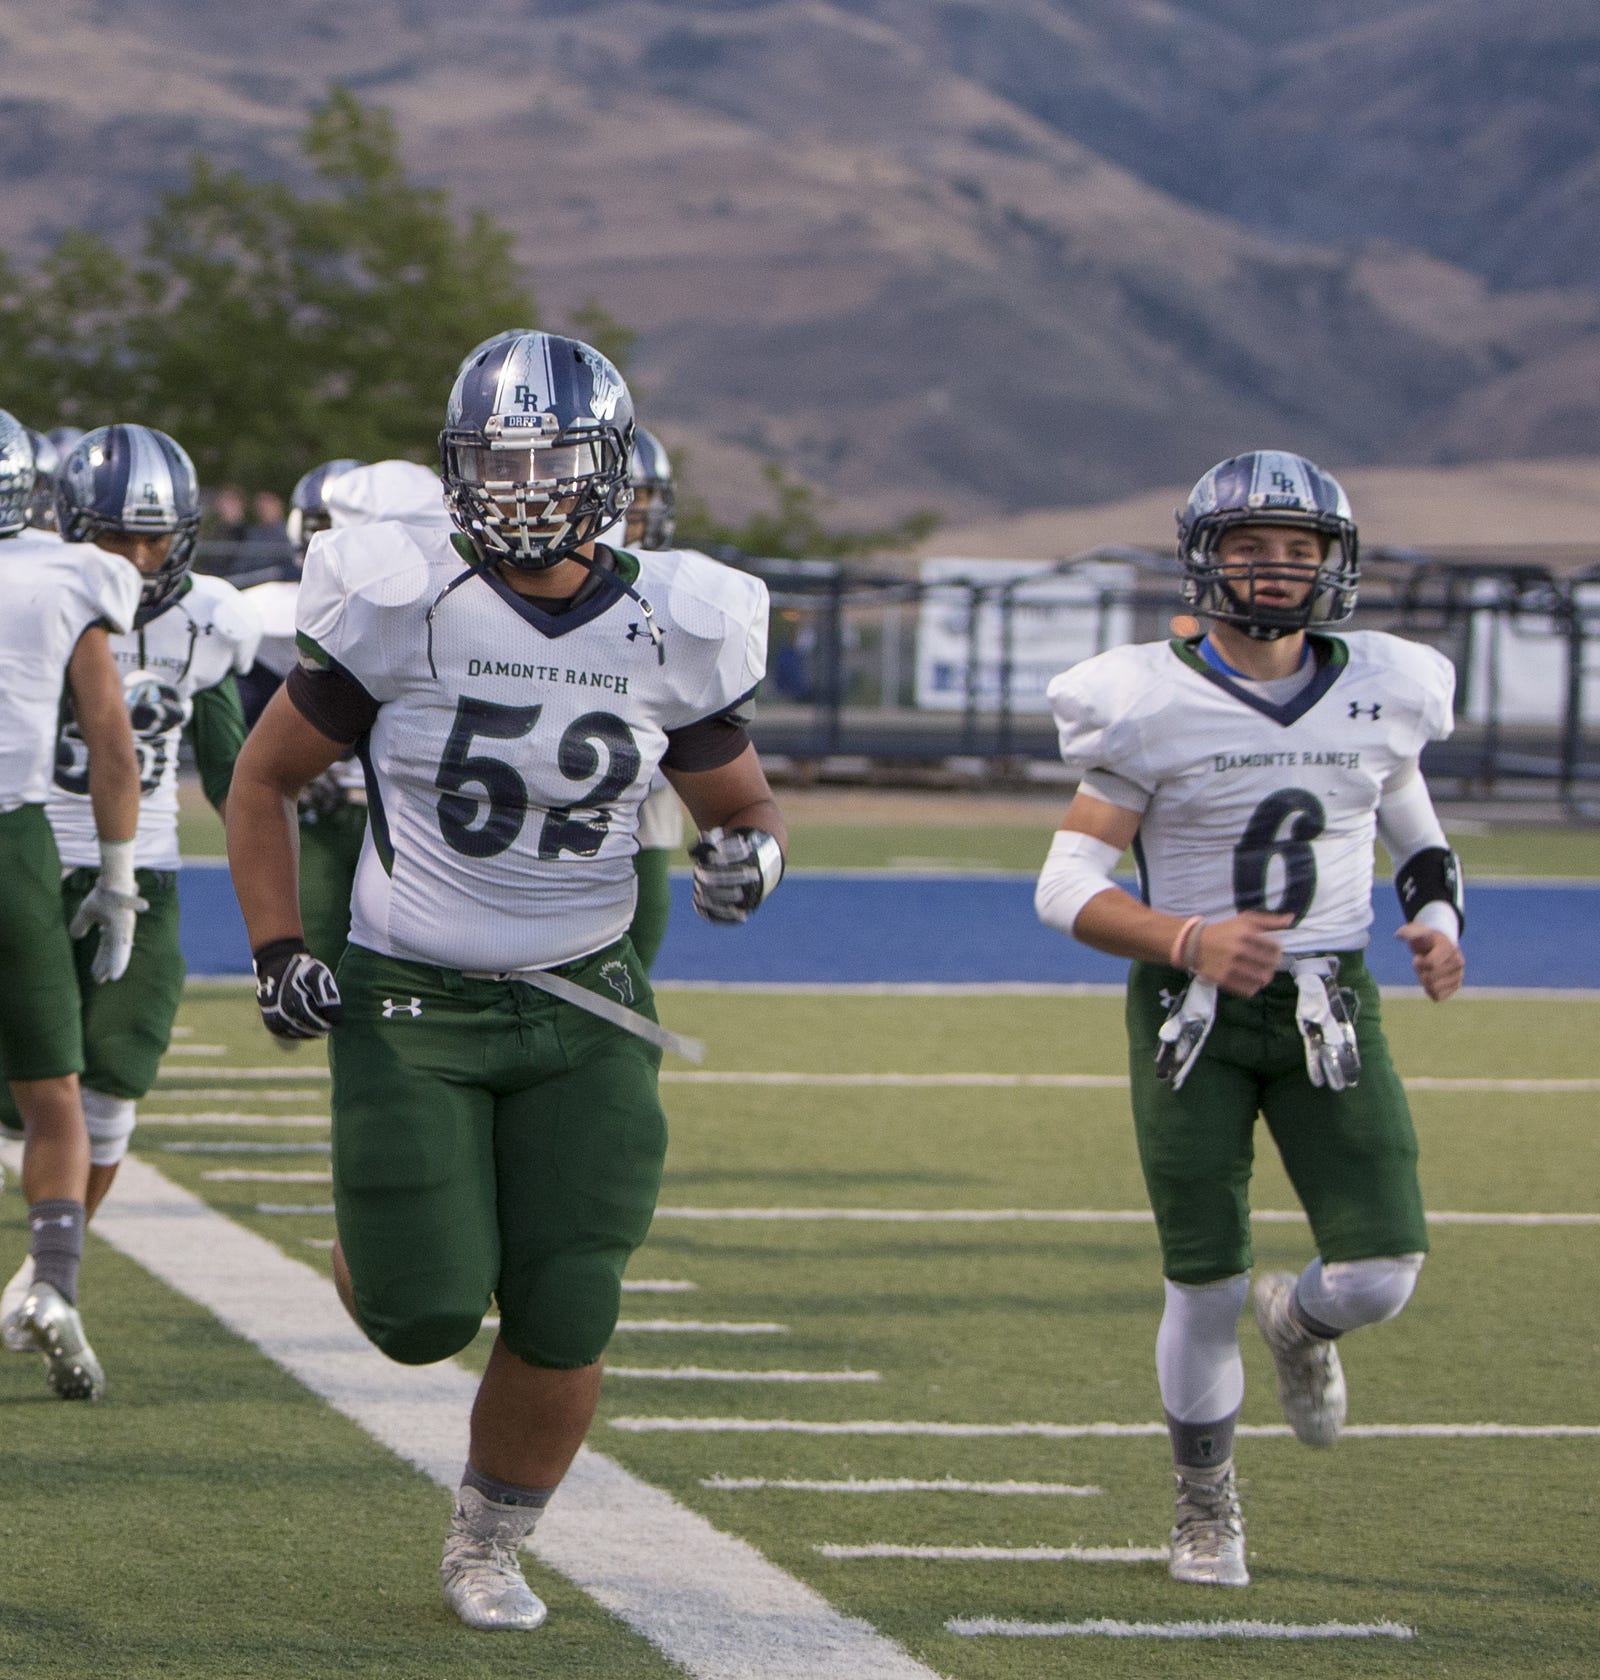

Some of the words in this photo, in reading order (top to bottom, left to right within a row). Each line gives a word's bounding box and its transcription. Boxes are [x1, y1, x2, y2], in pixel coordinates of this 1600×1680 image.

[515, 385, 538, 412] DR
[509, 416, 537, 427] DRFP
[1272, 471, 1294, 493] DR
[468, 659, 559, 682] DAMONTE
[565, 669, 629, 694] RANCH
[1215, 752, 1297, 772] DAMONTE
[1302, 752, 1360, 769] RANCH
[435, 693, 641, 860] 52
[1234, 786, 1326, 929] 6
